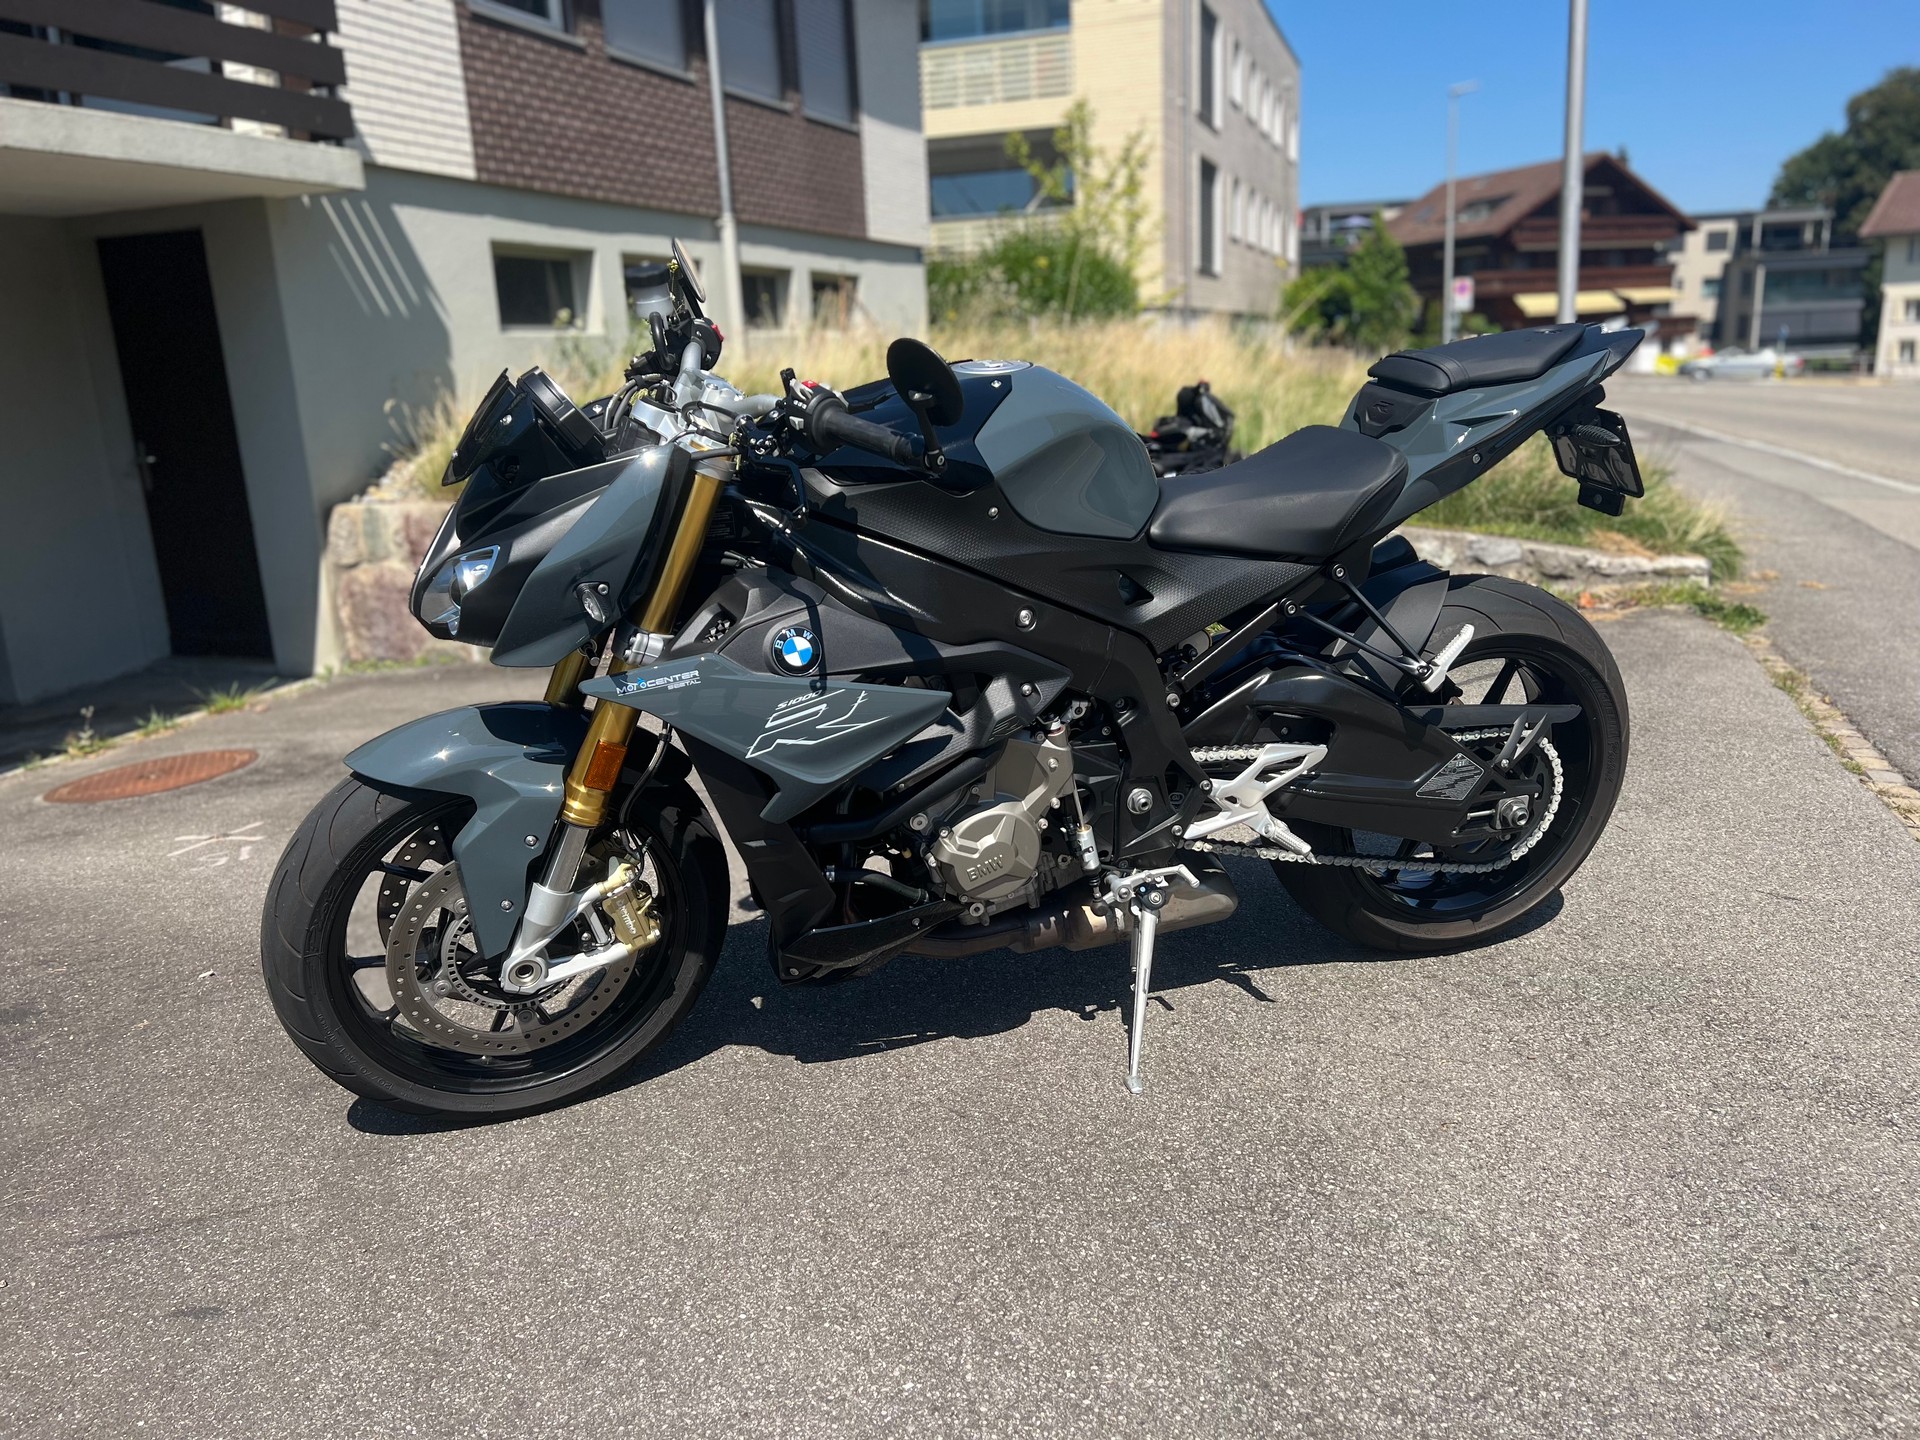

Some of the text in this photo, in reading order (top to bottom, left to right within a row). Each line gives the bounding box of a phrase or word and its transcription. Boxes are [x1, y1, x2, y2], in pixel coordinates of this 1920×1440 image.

[774, 628, 813, 649] BMW
[616, 669, 700, 694] MOTOCENTER
[966, 854, 1003, 882] BMW
